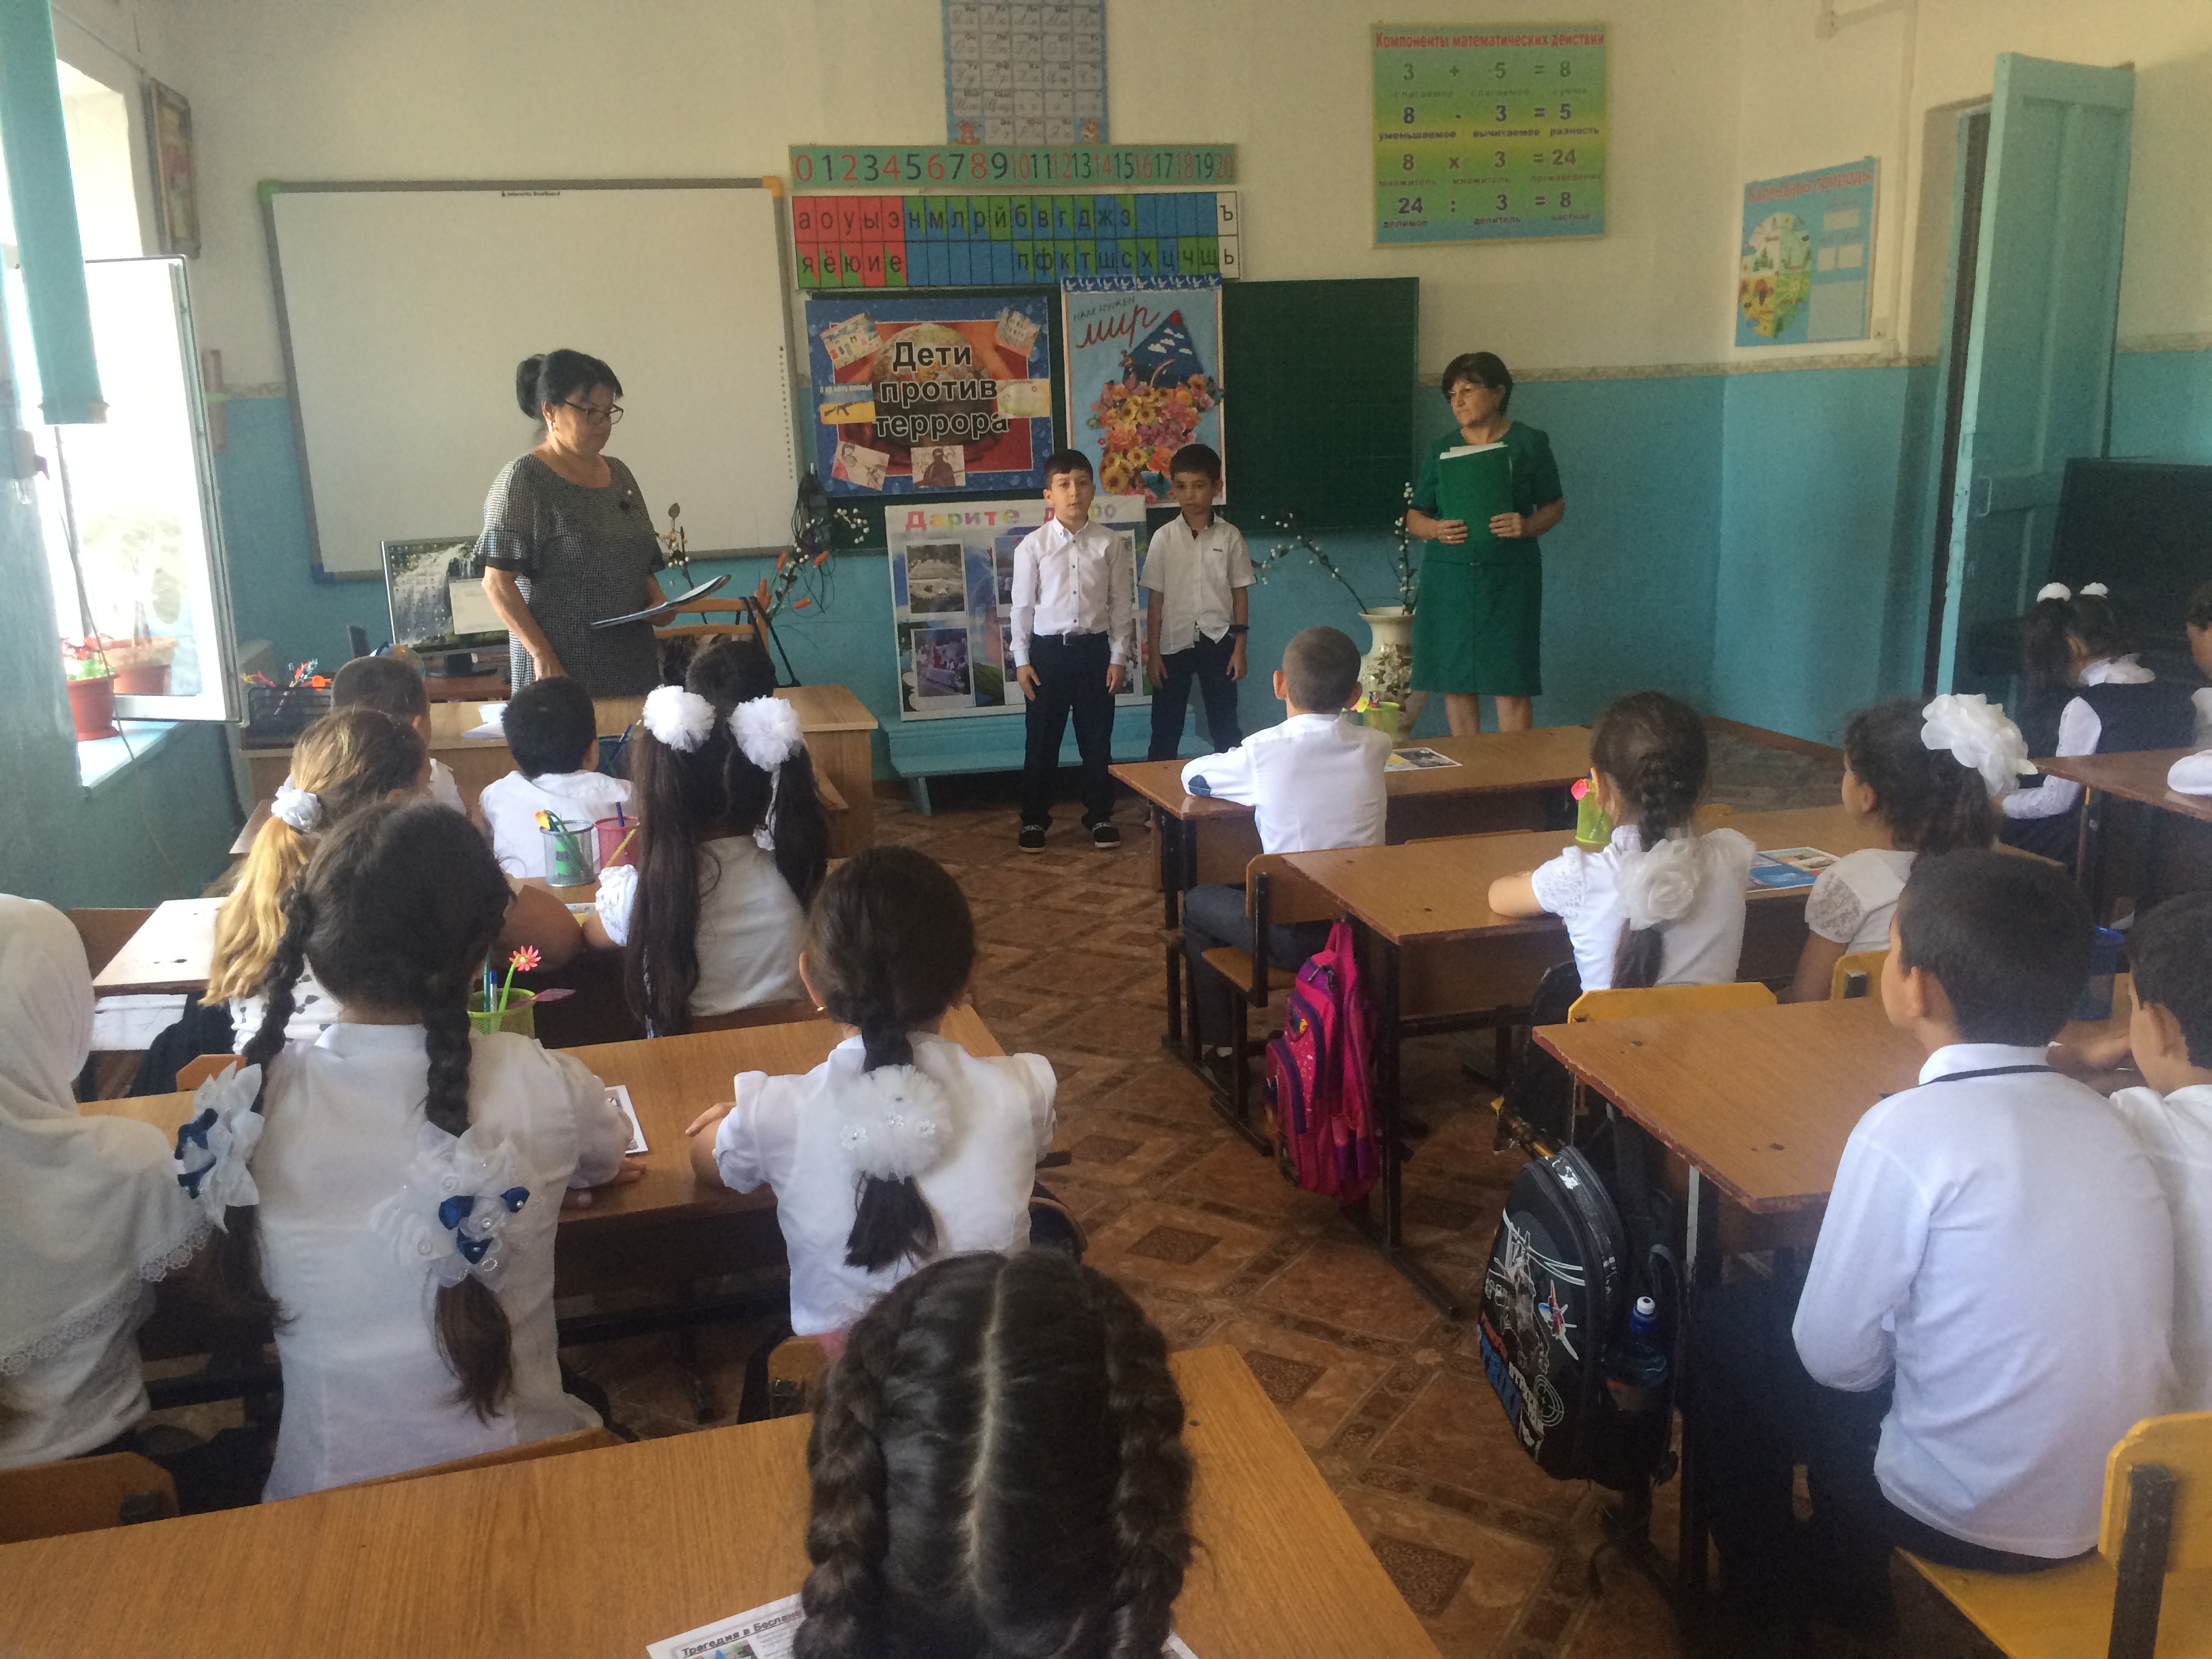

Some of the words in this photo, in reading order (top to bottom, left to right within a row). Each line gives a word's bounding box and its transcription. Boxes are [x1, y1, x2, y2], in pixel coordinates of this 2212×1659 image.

[1376, 32, 1449, 48] Компоненты
[1404, 63, 1414, 80] 3
[1495, 62, 1506, 79] 5
[1560, 60, 1571, 77] 8
[1404, 106, 1415, 123] 8
[1496, 105, 1507, 122] 3
[1560, 103, 1571, 120] 5
[1378, 131, 1456, 142] уменьшаемое
[1550, 127, 1599, 137] разность
[795, 155, 813, 182] 0
[822, 155, 833, 181] 1
[841, 154, 859, 181] 2
[863, 154, 879, 181] 3
[882, 155, 901, 180] 4
[907, 153, 921, 180] 5
[927, 152, 945, 180] 6
[949, 153, 964, 180] 7
[970, 152, 987, 179] 8
[991, 152, 1008, 179] 9
[1010, 152, 1031, 180] 10
[1031, 152, 1051, 179] 11
[1051, 152, 1072, 179] 12
[1071, 152, 1091, 179] 13
[1093, 152, 1111, 178] 14
[1114, 152, 1134, 179] 15
[1134, 153, 1152, 179] 16
[1155, 152, 1173, 179] 17
[1175, 152, 1194, 179] 18
[1195, 152, 1214, 179] 19
[1214, 153, 1233, 179] 20
[1403, 154, 1414, 170] 8
[1494, 150, 1506, 168] 3
[1552, 148, 1576, 166] 24
[1398, 197, 1423, 214] 24
[1496, 194, 1508, 211] 3
[1560, 191, 1571, 208] 8
[1474, 216, 1521, 226] делитель
[1076, 304, 1160, 349] мир
[892, 340, 972, 373] Дети
[880, 379, 998, 409] против
[874, 412, 1010, 443] террора
[905, 509, 1020, 532] Дарите
[1044, 504, 1117, 525] дро
[681, 1631, 739, 1656] Трагедия
